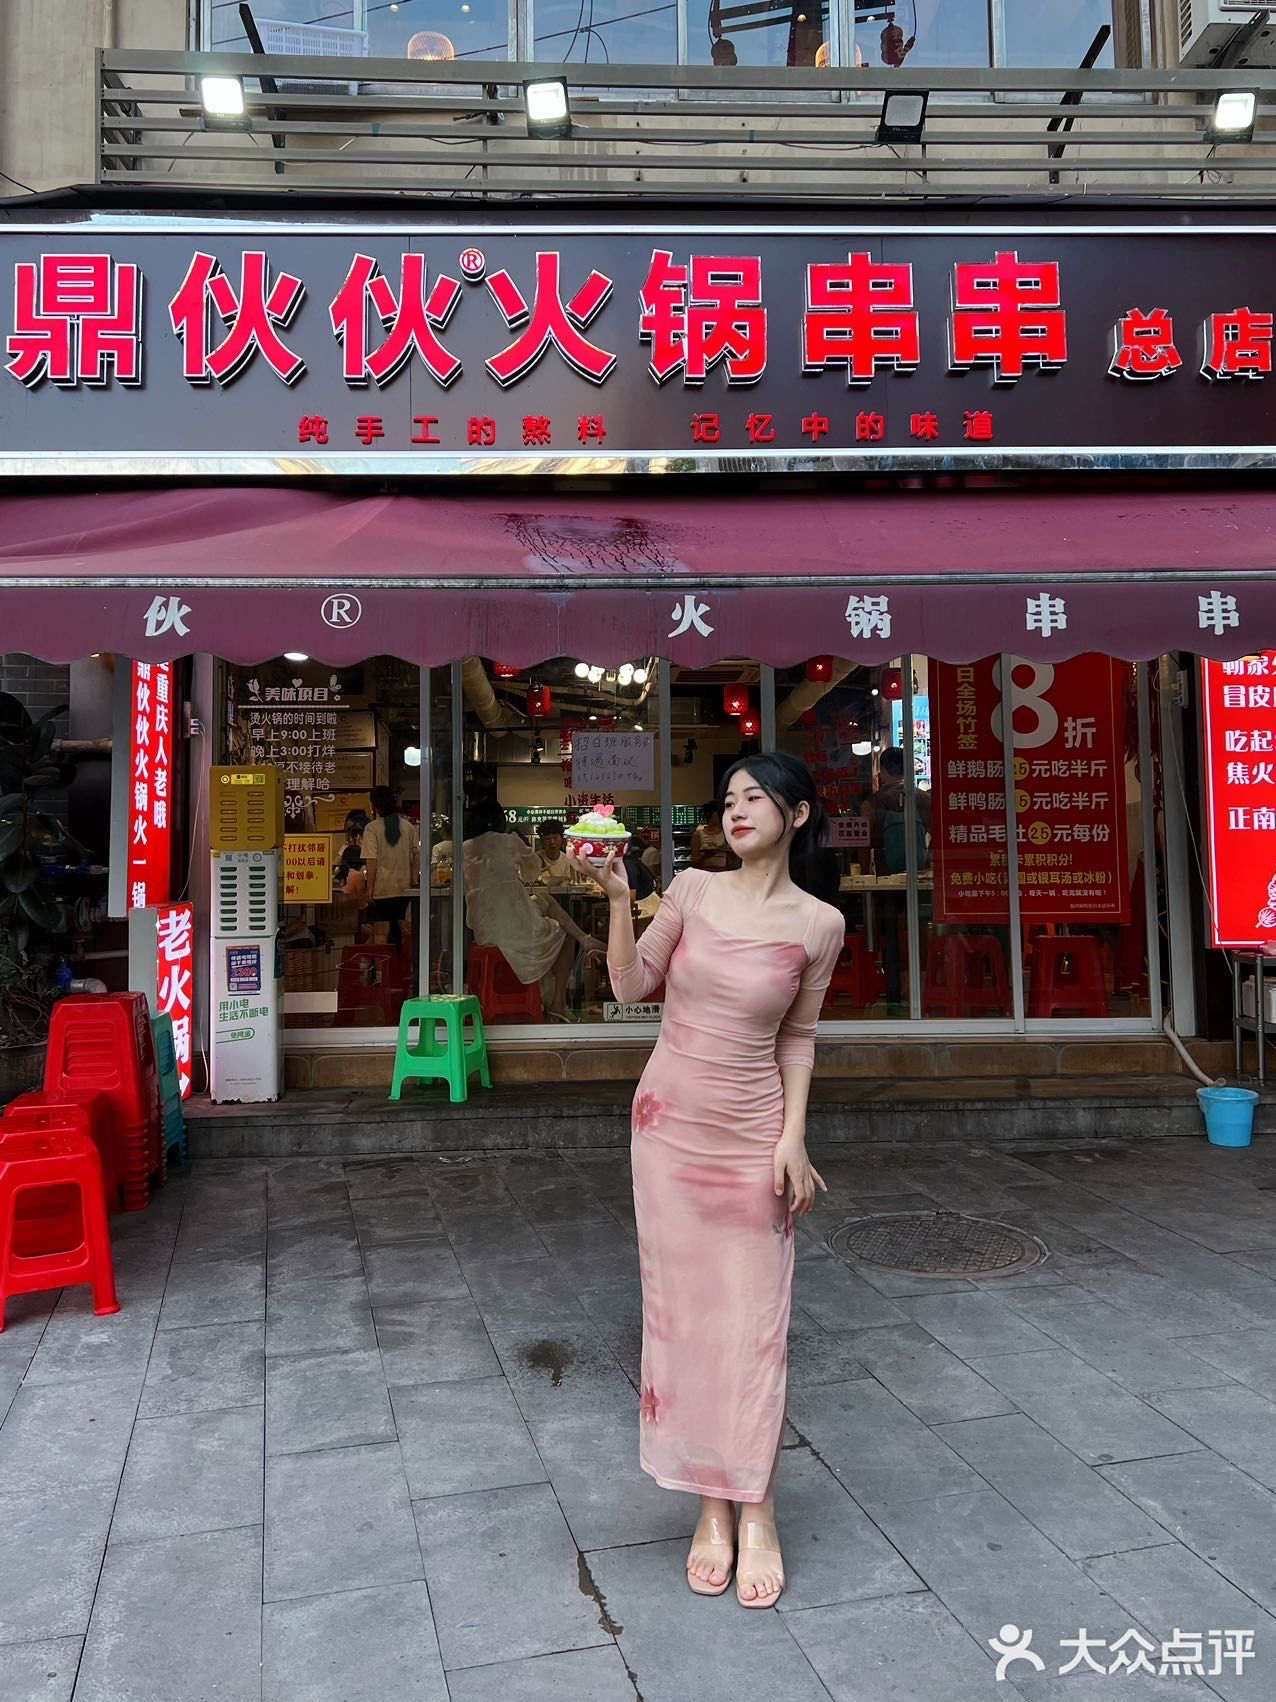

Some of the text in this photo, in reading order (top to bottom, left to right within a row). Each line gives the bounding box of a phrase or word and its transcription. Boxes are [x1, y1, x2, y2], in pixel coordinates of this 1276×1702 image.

[1108, 307, 1274, 381] 总店
[298, 411, 994, 445] 纯手工的熬料 记忆中的味道
[265, 687, 328, 701] 美味项目
[1223, 684, 1276, 708] 冒皮
[250, 712, 337, 725] 烫火锅的时间到啦
[251, 728, 336, 741] 早上9:00上班
[1225, 730, 1276, 752] 吃起
[251, 745, 336, 757] 晚上3:00打烊
[948, 792, 1109, 810] 鲜鸭肠5元吃半斤
[219, 999, 249, 1012] 用小电
[625, 1005, 661, 1014] 小心地滑
[219, 1006, 269, 1022] 生活不断电
